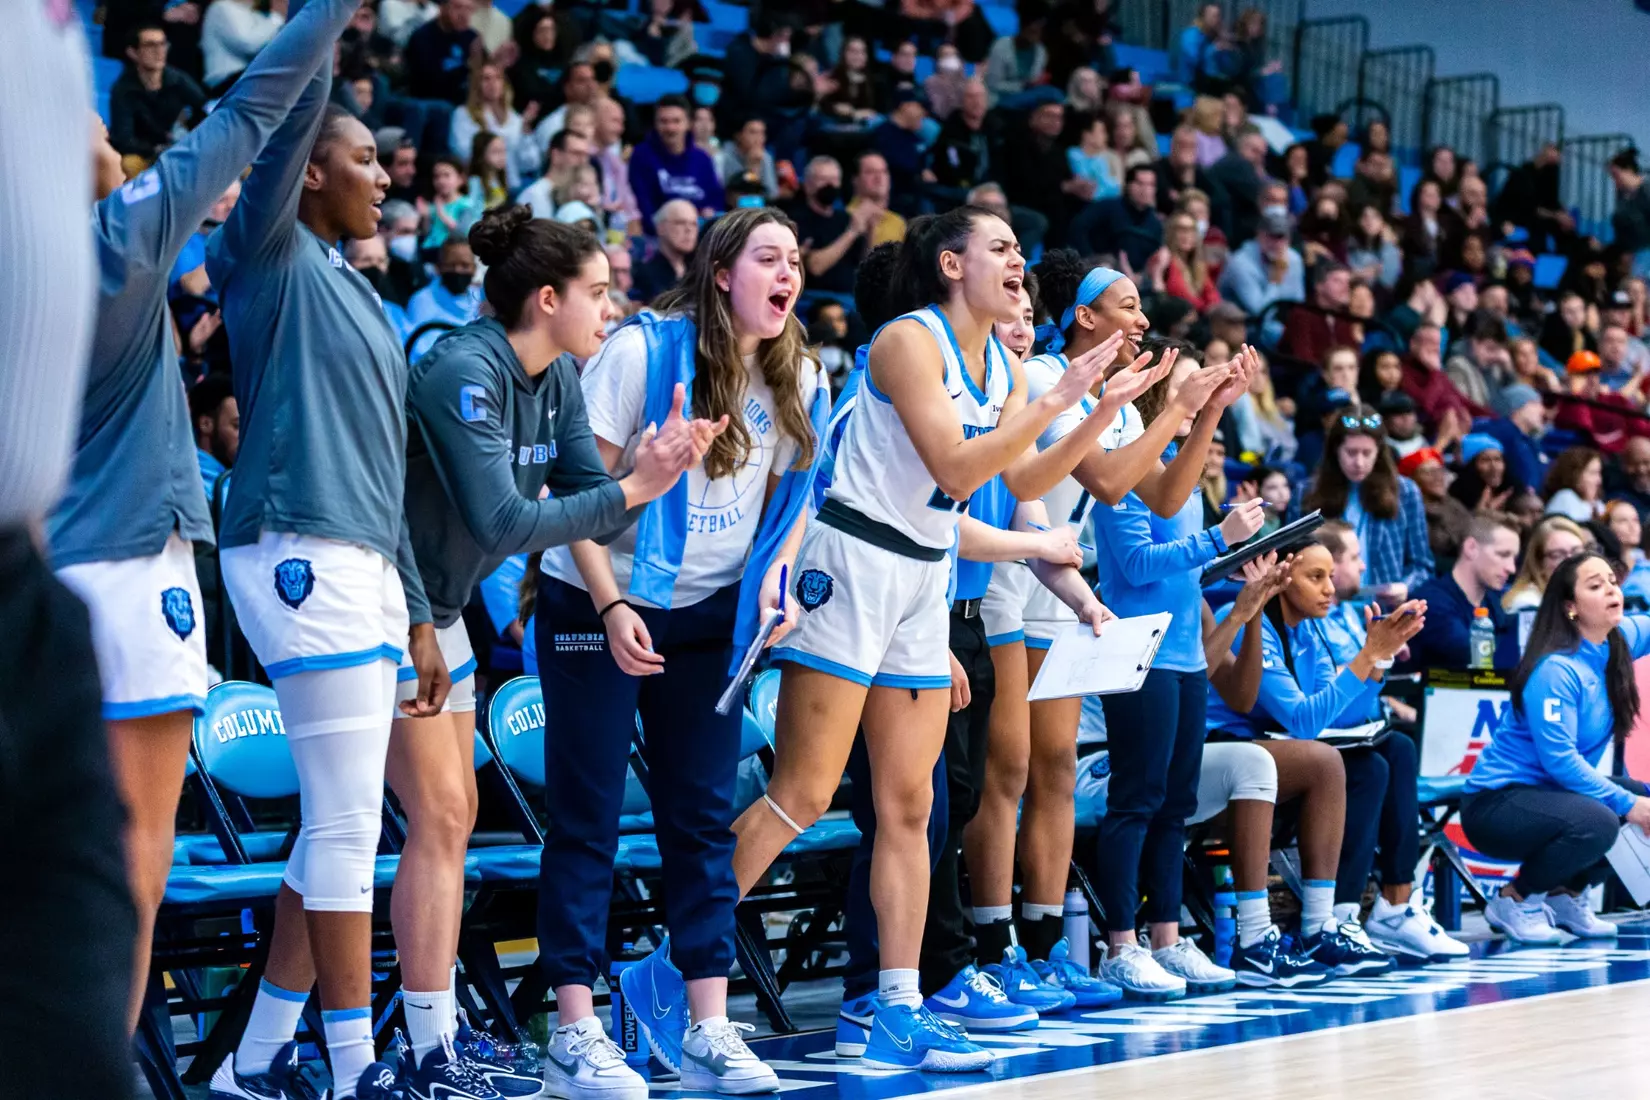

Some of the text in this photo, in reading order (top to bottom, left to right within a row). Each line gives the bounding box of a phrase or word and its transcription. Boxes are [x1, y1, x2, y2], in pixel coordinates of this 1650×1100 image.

[461, 386, 487, 421] C
[744, 398, 771, 434] IONS
[687, 507, 744, 533] ETBALL
[554, 633, 604, 641] COLUMBIA
[1544, 698, 1561, 721] C
